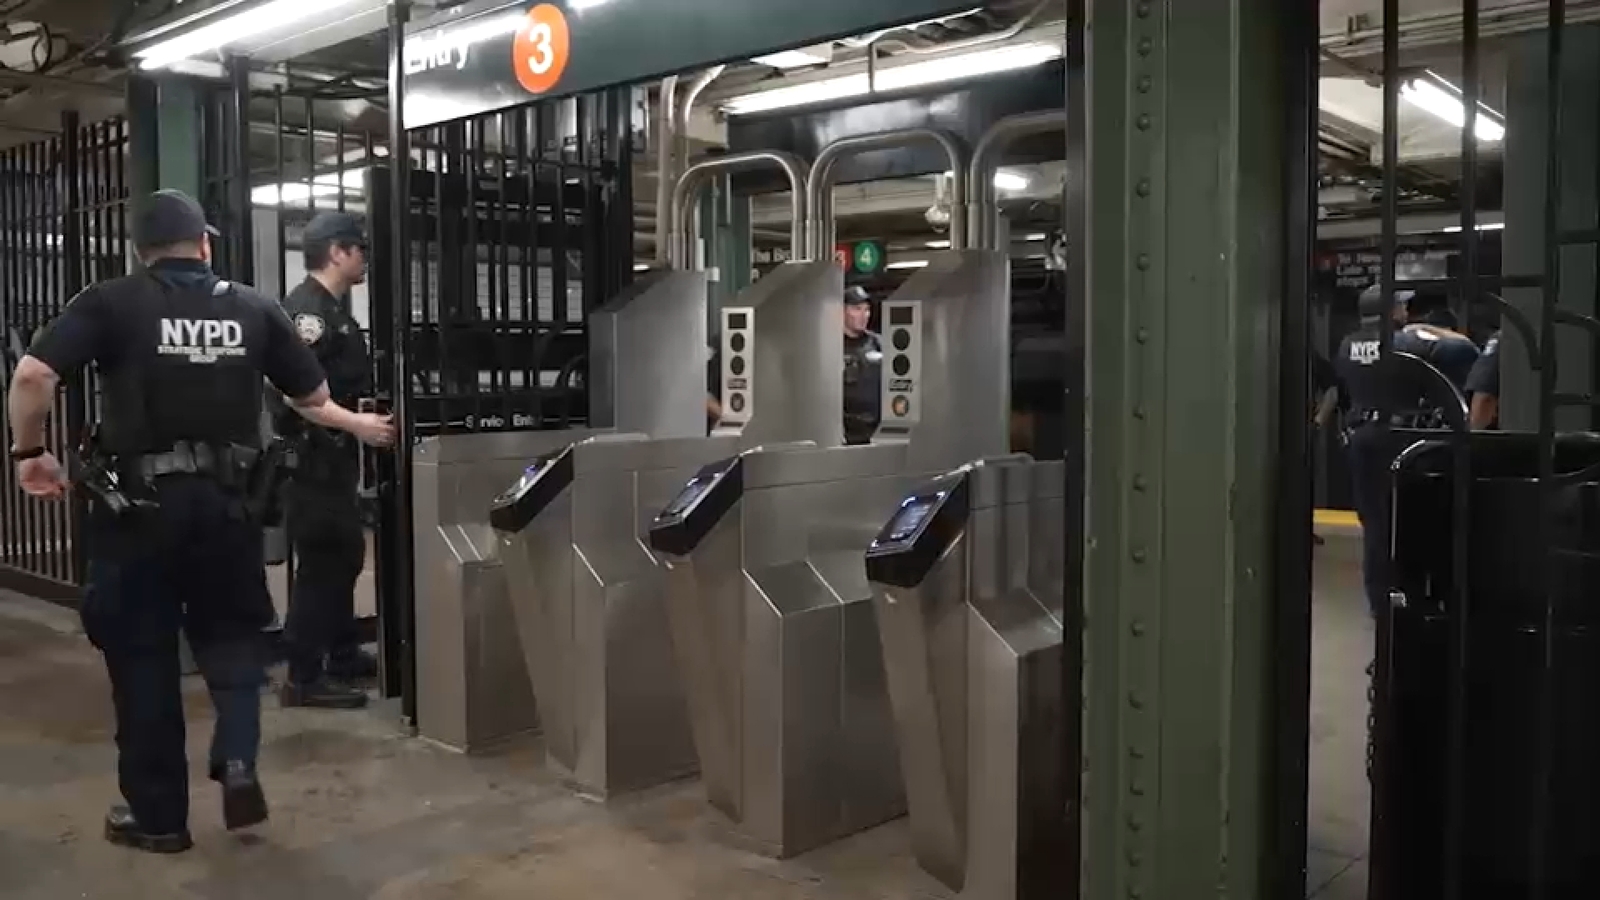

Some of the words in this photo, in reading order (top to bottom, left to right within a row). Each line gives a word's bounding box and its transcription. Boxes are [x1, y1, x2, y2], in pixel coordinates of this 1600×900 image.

[527, 23, 554, 74] 3
[859, 246, 873, 266] 4
[160, 317, 243, 347] NYPD
